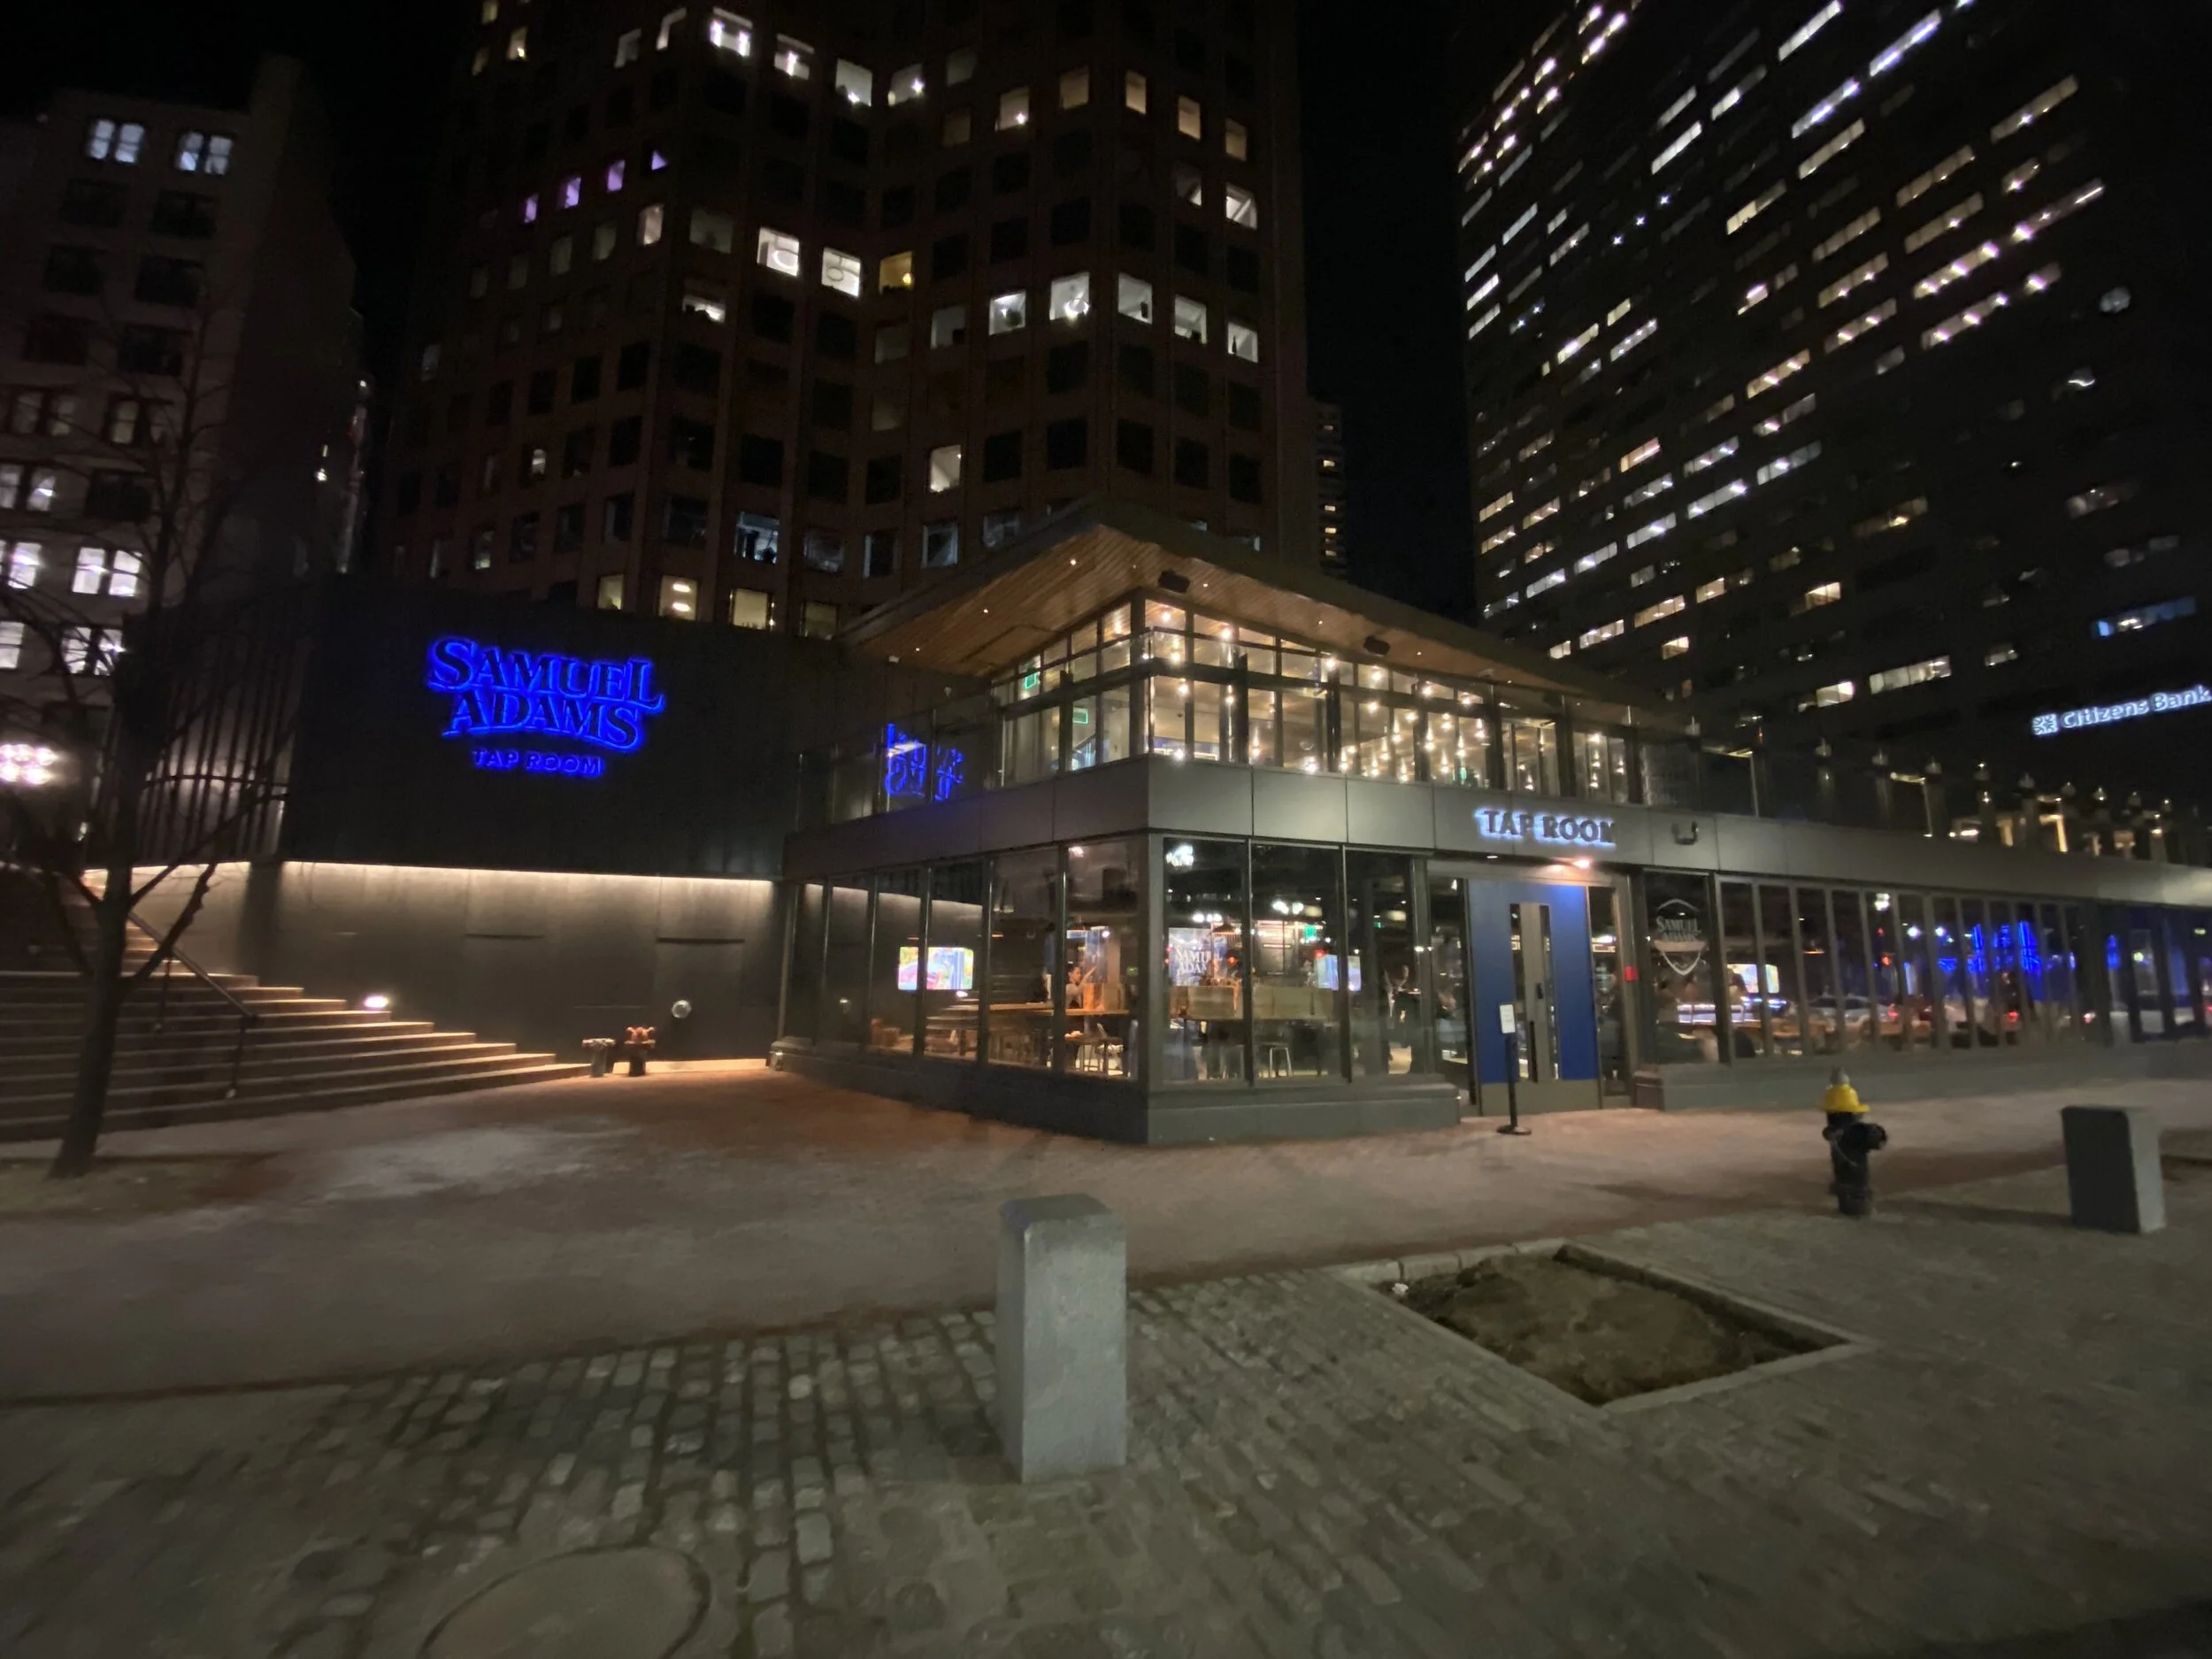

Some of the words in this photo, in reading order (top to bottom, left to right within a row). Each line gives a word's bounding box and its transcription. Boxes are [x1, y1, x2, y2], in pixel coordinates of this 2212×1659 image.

[427, 636, 666, 710] SAMUEL
[442, 689, 643, 752] ADAMS
[2062, 699, 2150, 729] Citizens
[2151, 684, 2212, 712] Bank
[474, 749, 519, 771] TAP
[525, 753, 604, 778] ROOM
[1480, 809, 1533, 838] TAP
[1540, 813, 1616, 846] ROOM
